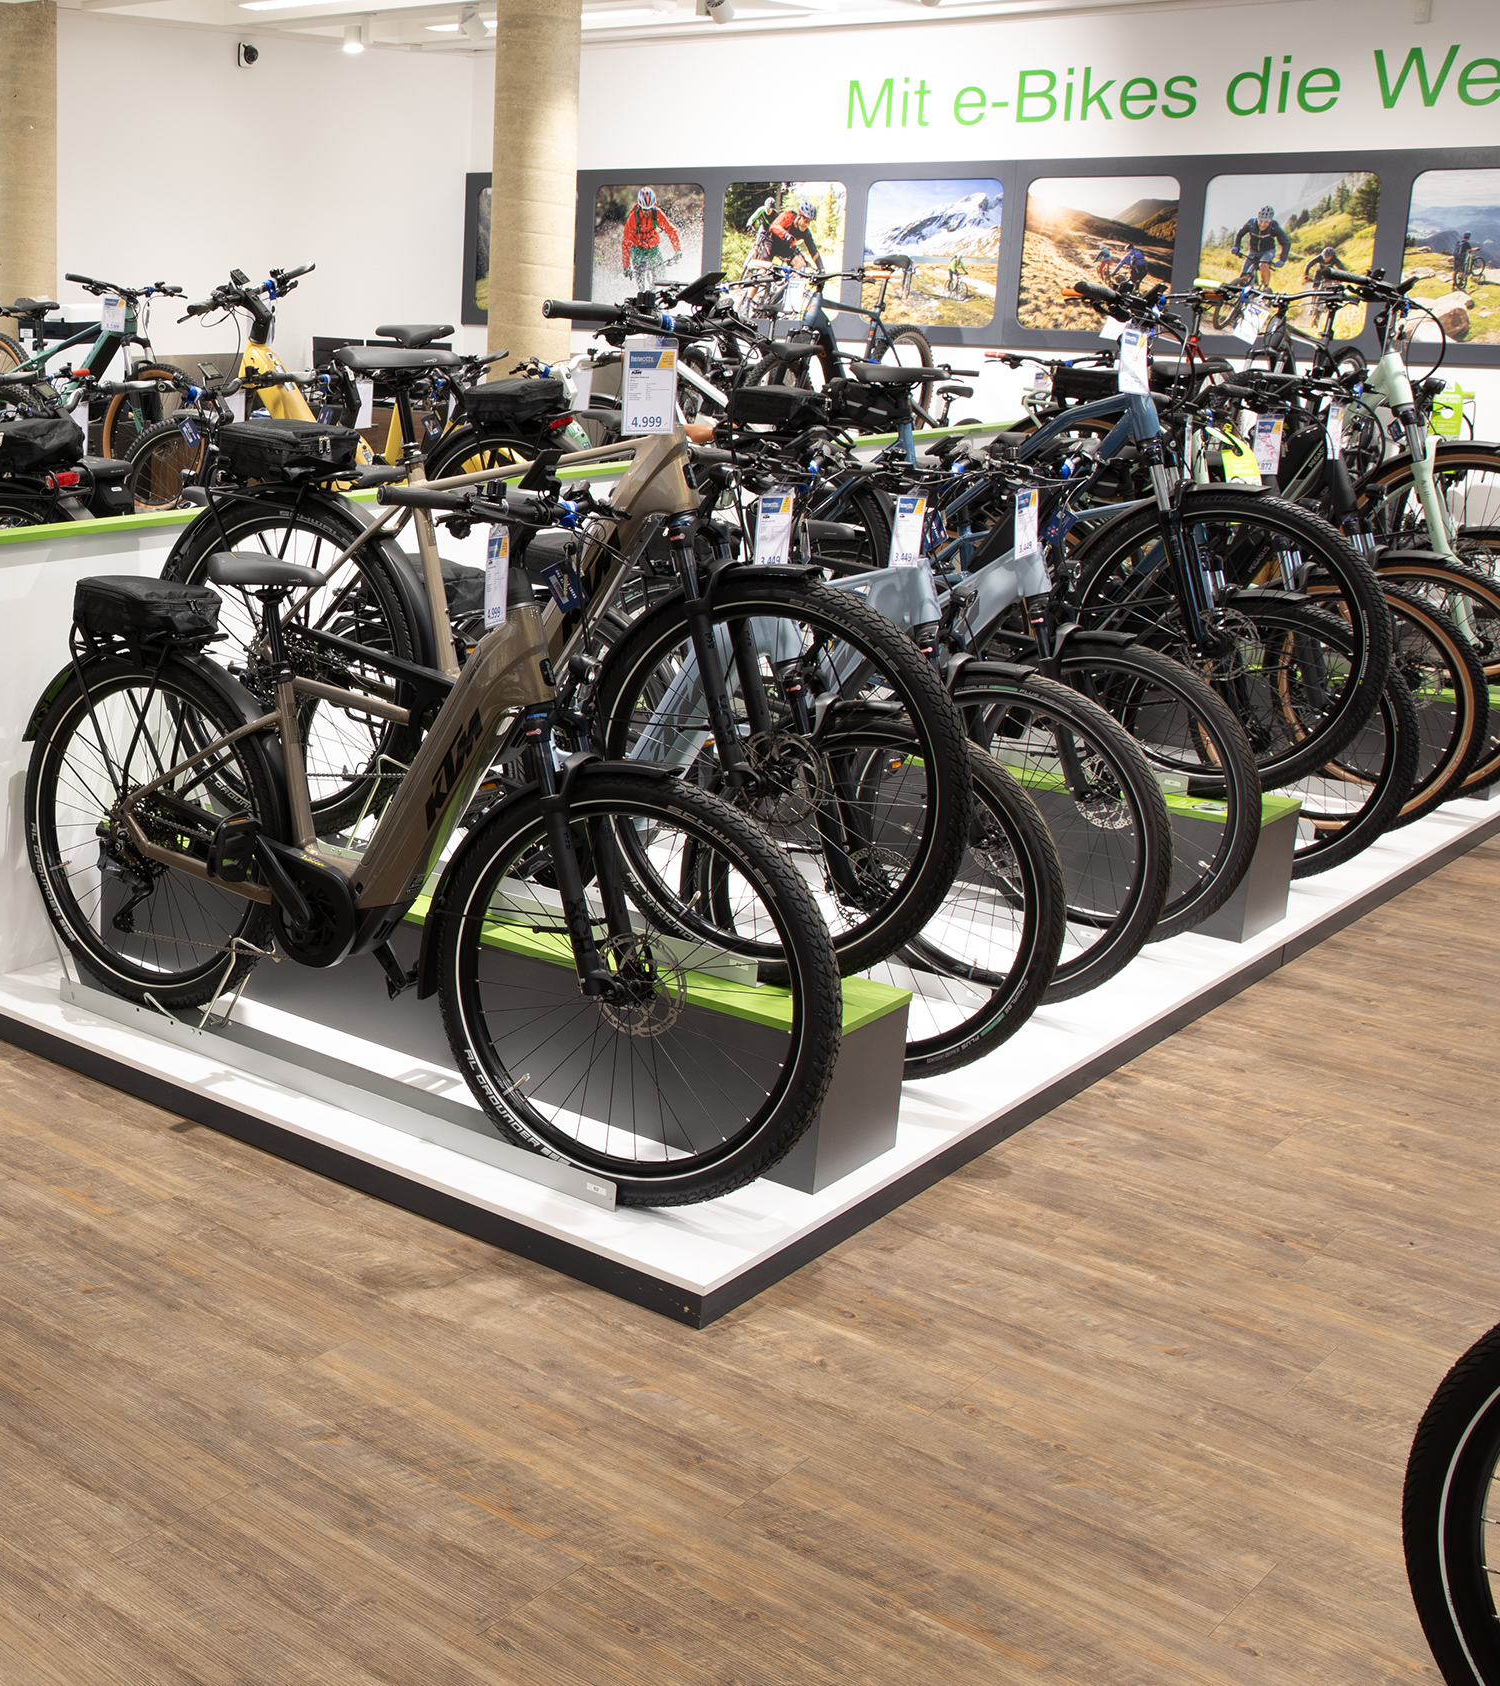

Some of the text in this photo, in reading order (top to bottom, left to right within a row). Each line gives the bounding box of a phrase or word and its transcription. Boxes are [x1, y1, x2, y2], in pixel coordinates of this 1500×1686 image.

[846, 43, 1500, 129] Mit e-Bikes die We
[631, 416, 662, 428] 4.999
[1257, 462, 1271, 471] .872
[760, 555, 781, 564] 3.449
[894, 552, 912, 562] 3.449
[487, 606, 501, 619] 4.999
[789, 599, 901, 672] SCHWALBE
[425, 708, 484, 832] KTM
[30, 822, 62, 920] AL GROUNDER
[667, 804, 778, 898] SCHWALBE
[464, 1048, 541, 1148] AL GROUNDER
